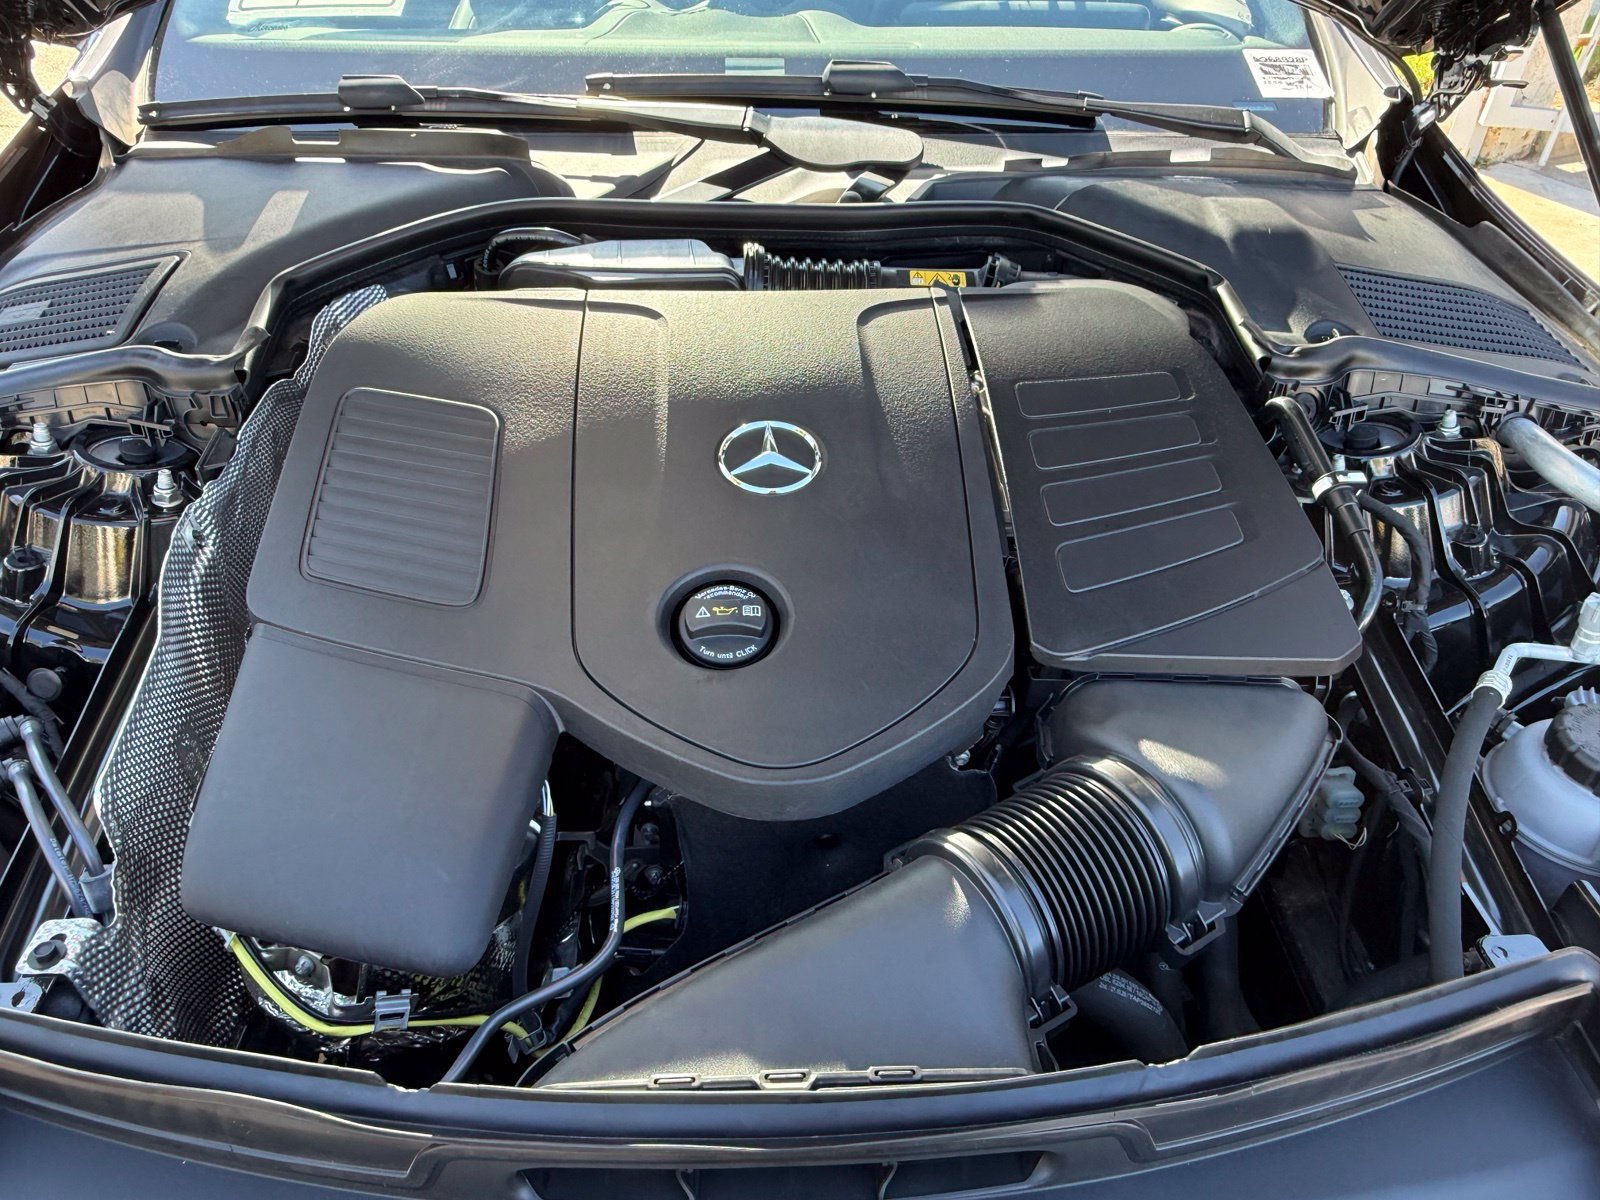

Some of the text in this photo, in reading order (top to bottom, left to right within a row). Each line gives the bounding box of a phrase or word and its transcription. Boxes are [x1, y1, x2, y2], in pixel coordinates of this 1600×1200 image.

[694, 585, 747, 599] Mercedes-Benz
[699, 645, 715, 657] Turn
[736, 644, 758, 658] CLICK
